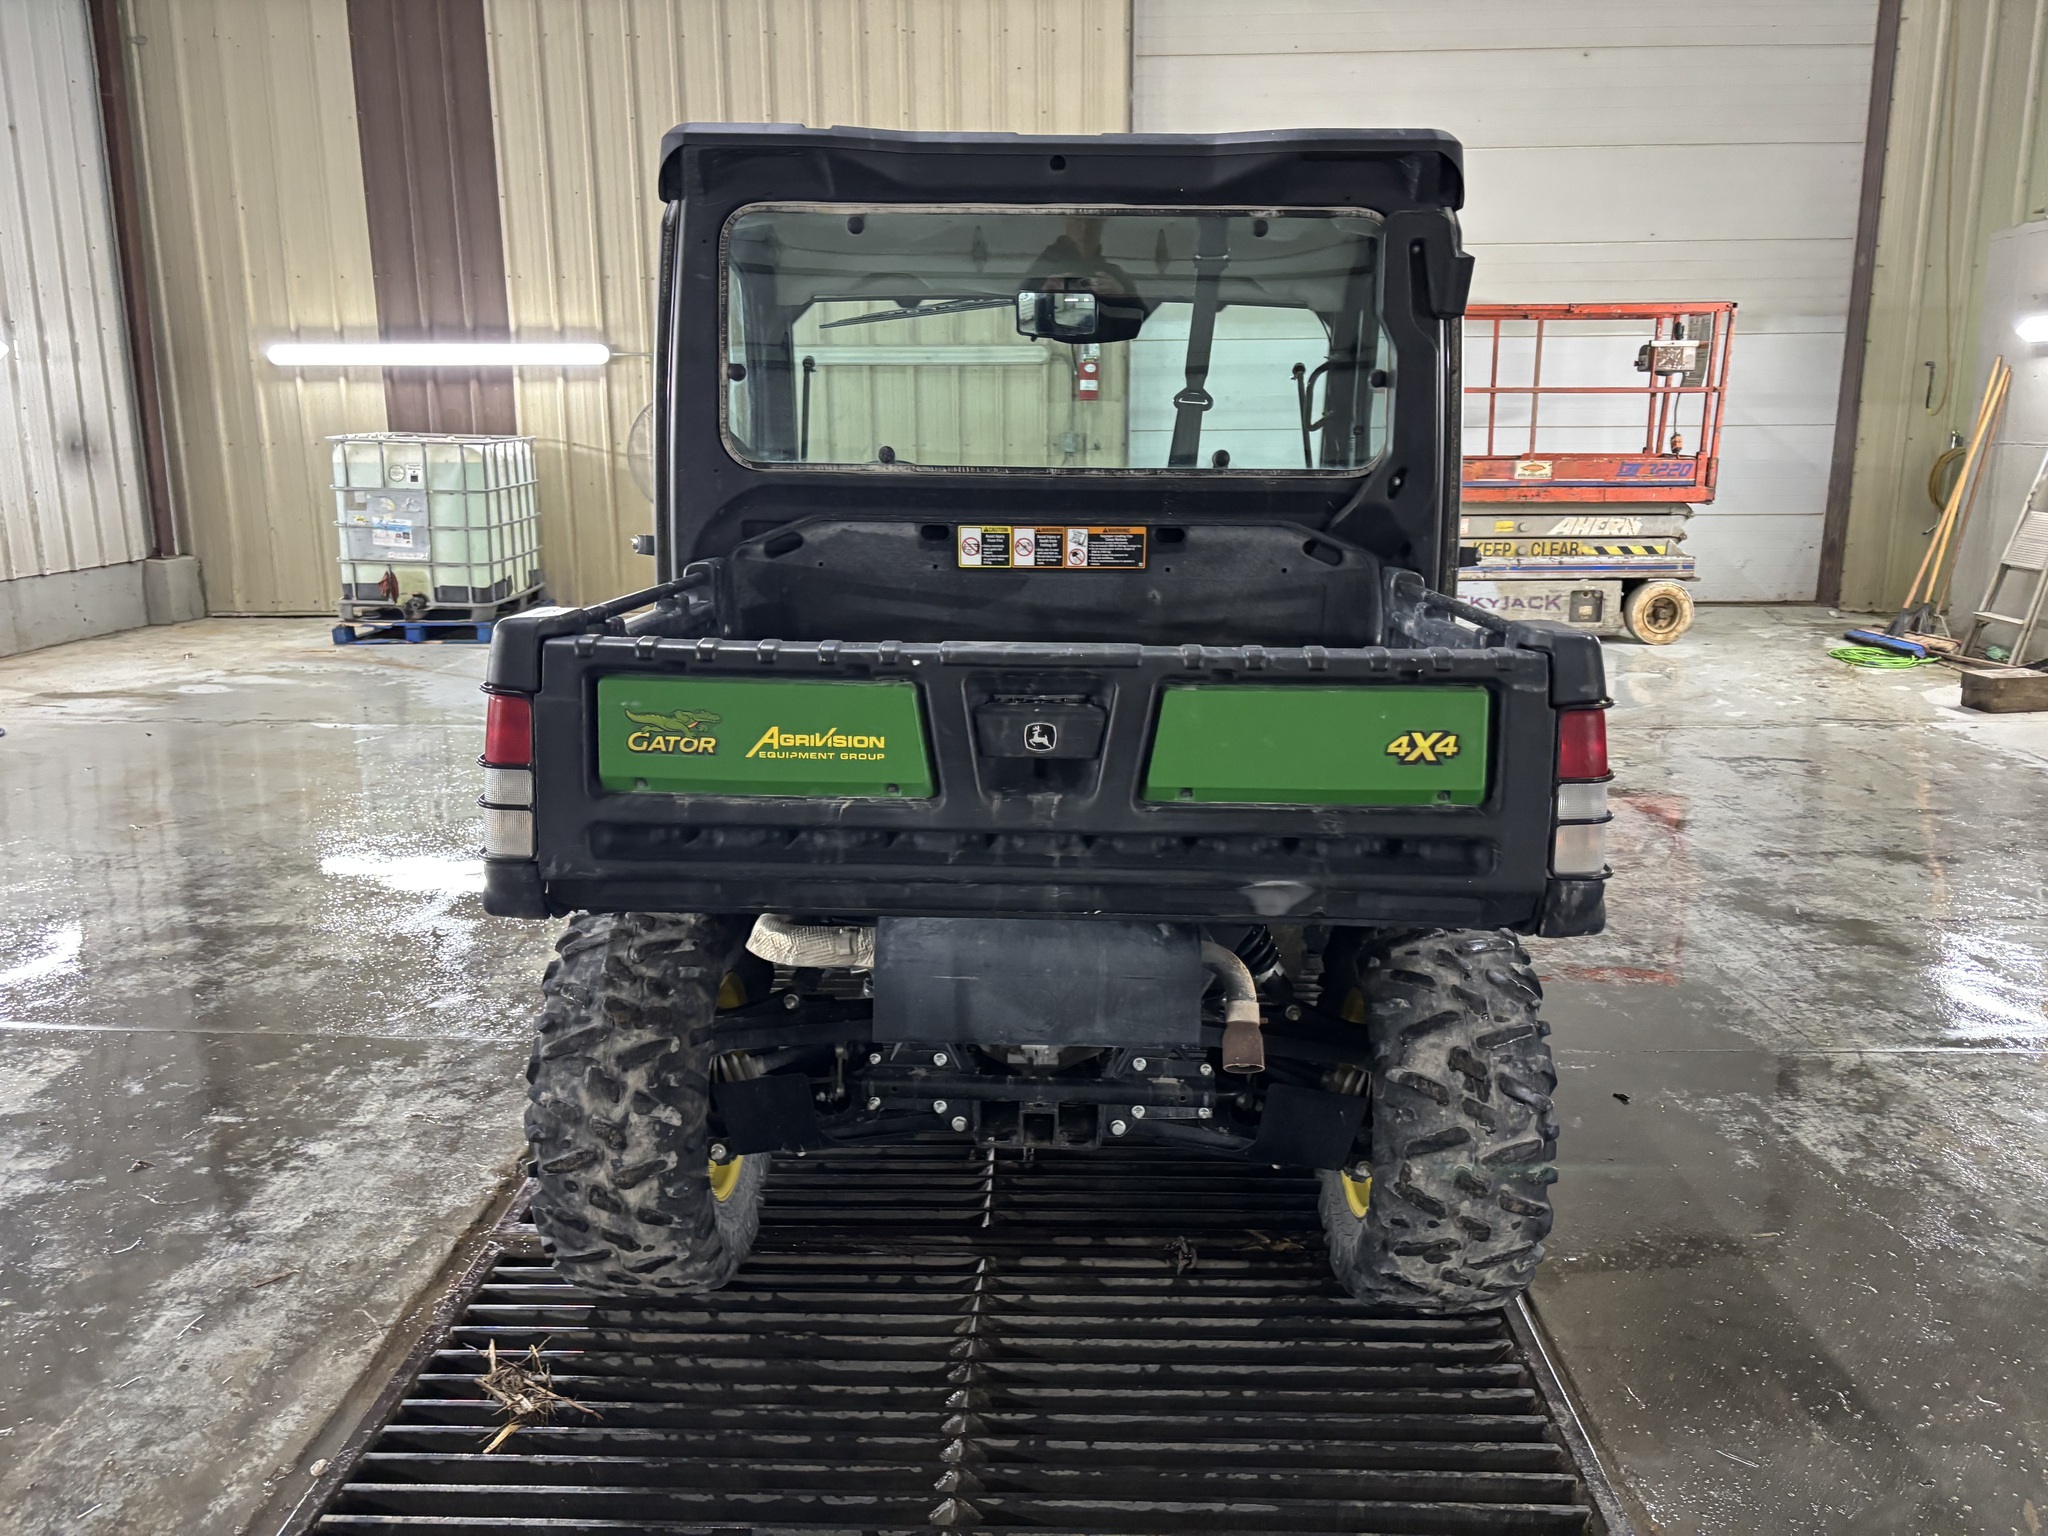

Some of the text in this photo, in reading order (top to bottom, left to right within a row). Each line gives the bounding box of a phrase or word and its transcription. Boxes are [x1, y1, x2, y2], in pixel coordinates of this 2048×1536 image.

[1547, 517, 1643, 535] AHERN
[1473, 541, 1579, 556] KEEP CLEAR
[1457, 594, 1563, 611] KYJACK
[627, 731, 716, 753] GATOR
[1386, 732, 1459, 761] 4X4
[758, 751, 885, 760] EQUIPMENT GROUP
